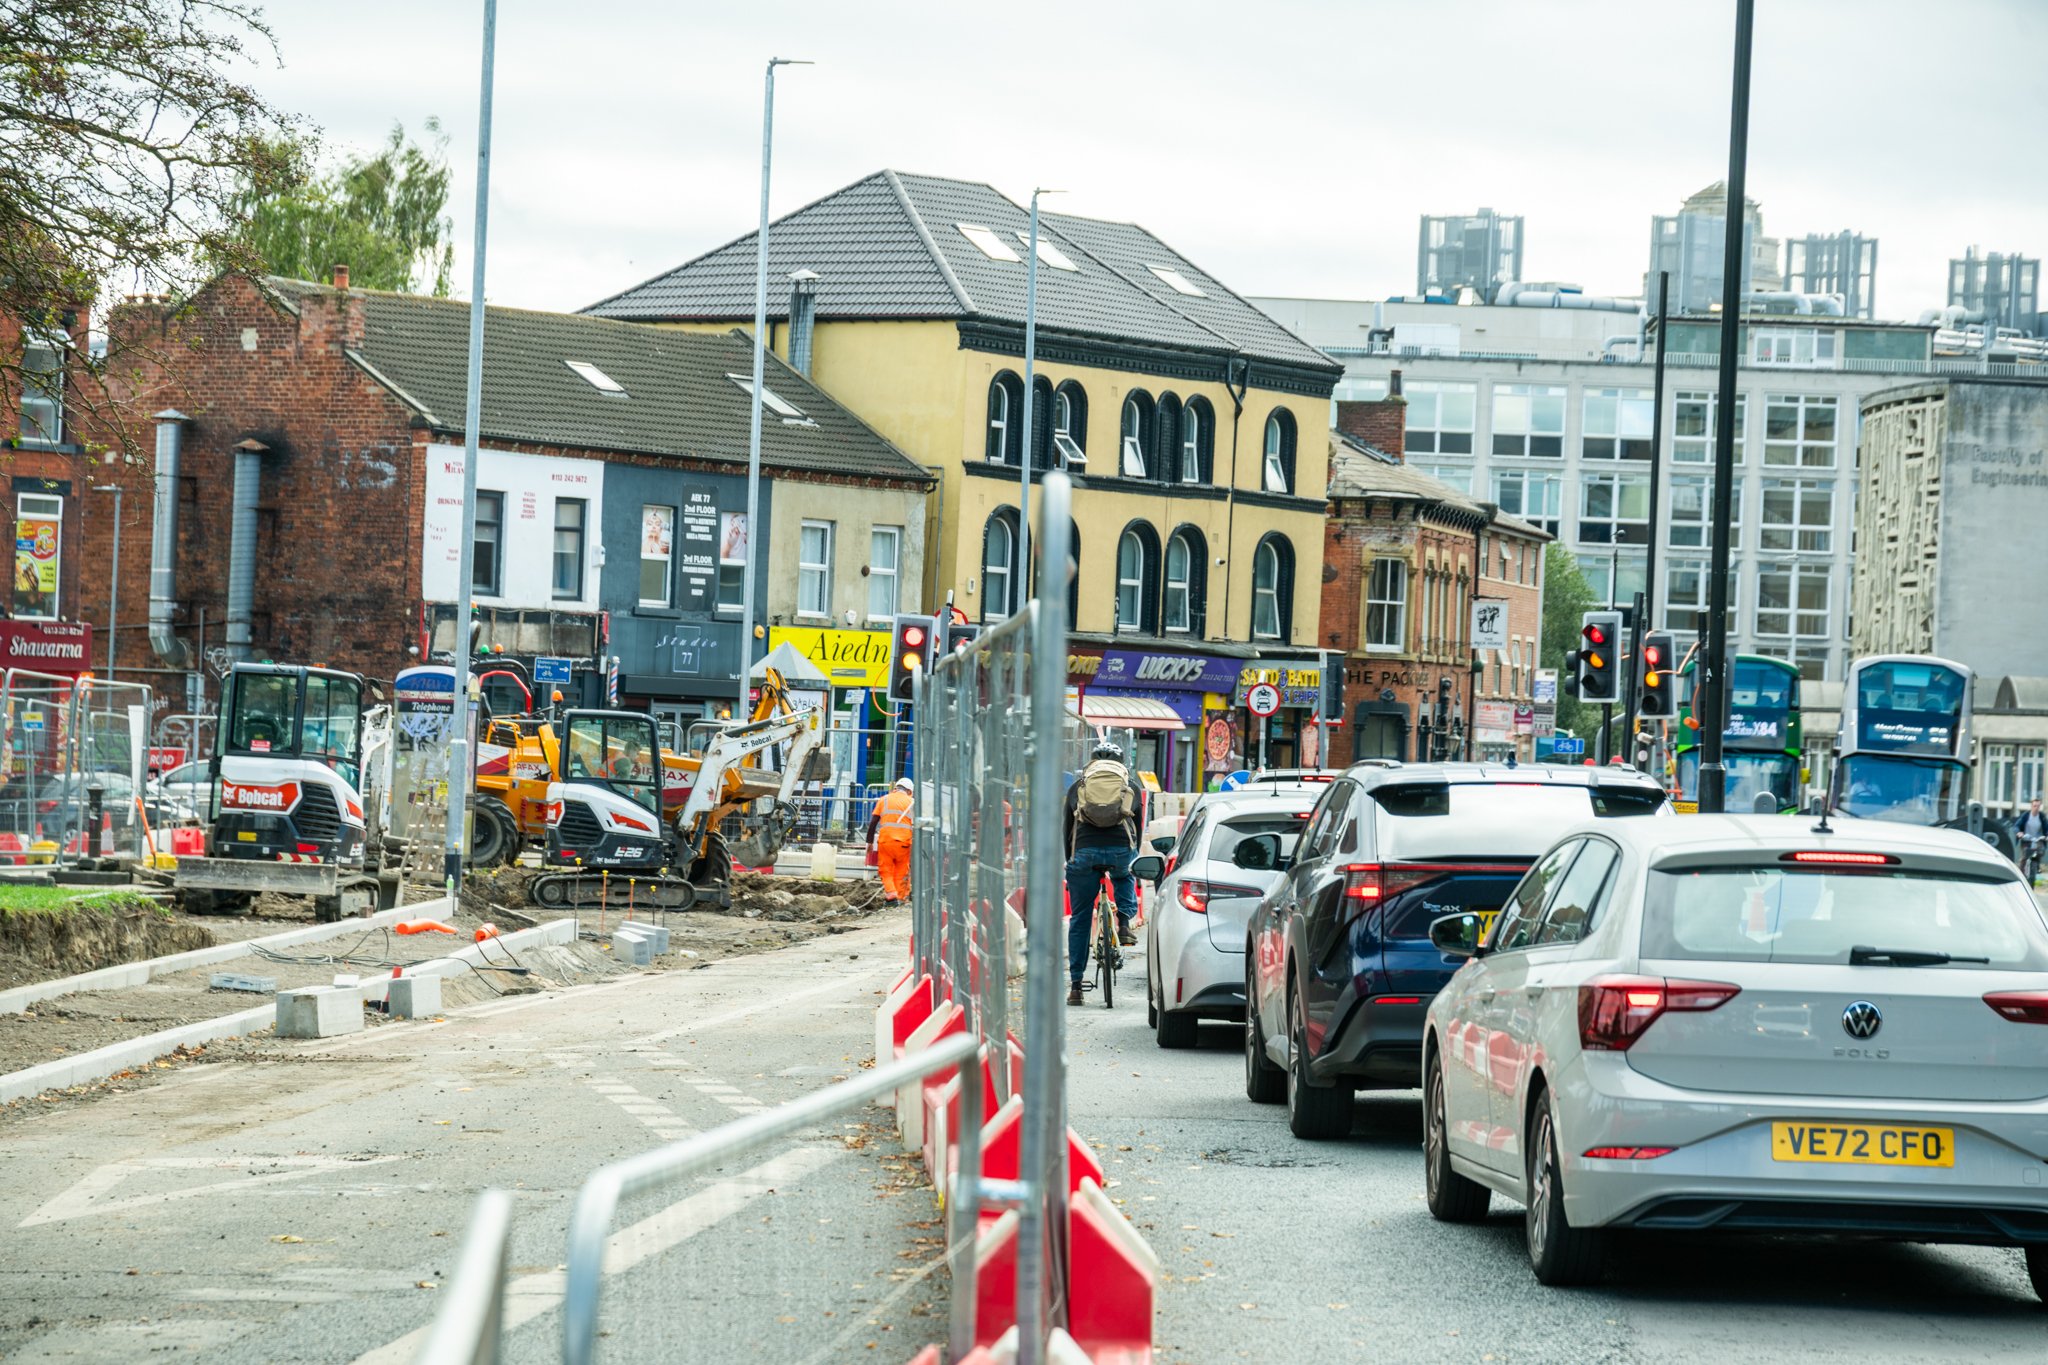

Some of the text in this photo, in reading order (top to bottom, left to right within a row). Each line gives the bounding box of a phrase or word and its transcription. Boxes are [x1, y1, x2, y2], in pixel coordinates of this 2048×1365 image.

[2029, 450, 2043, 465] of
[703, 494, 711, 503] 77
[685, 504, 716, 515] 2nd FLOOR
[683, 554, 713, 564] 3rd FLOOR
[9, 635, 83, 659] Shawarma
[655, 635, 718, 649] Studio
[681, 651, 693, 665] 77
[1135, 655, 1208, 681] LUCKYS
[1347, 670, 1374, 685] HE
[1292, 690, 1320, 703] CHIPS
[411, 702, 451, 713] Telephone
[1753, 721, 1778, 737] X84
[751, 735, 772, 747] Bobcat
[150, 754, 175, 766] ROAD
[238, 788, 284, 807] Bobcat
[615, 847, 644, 858] E26
[1833, 1047, 1890, 1060] POLO
[1787, 1126, 1870, 1157] VE72
